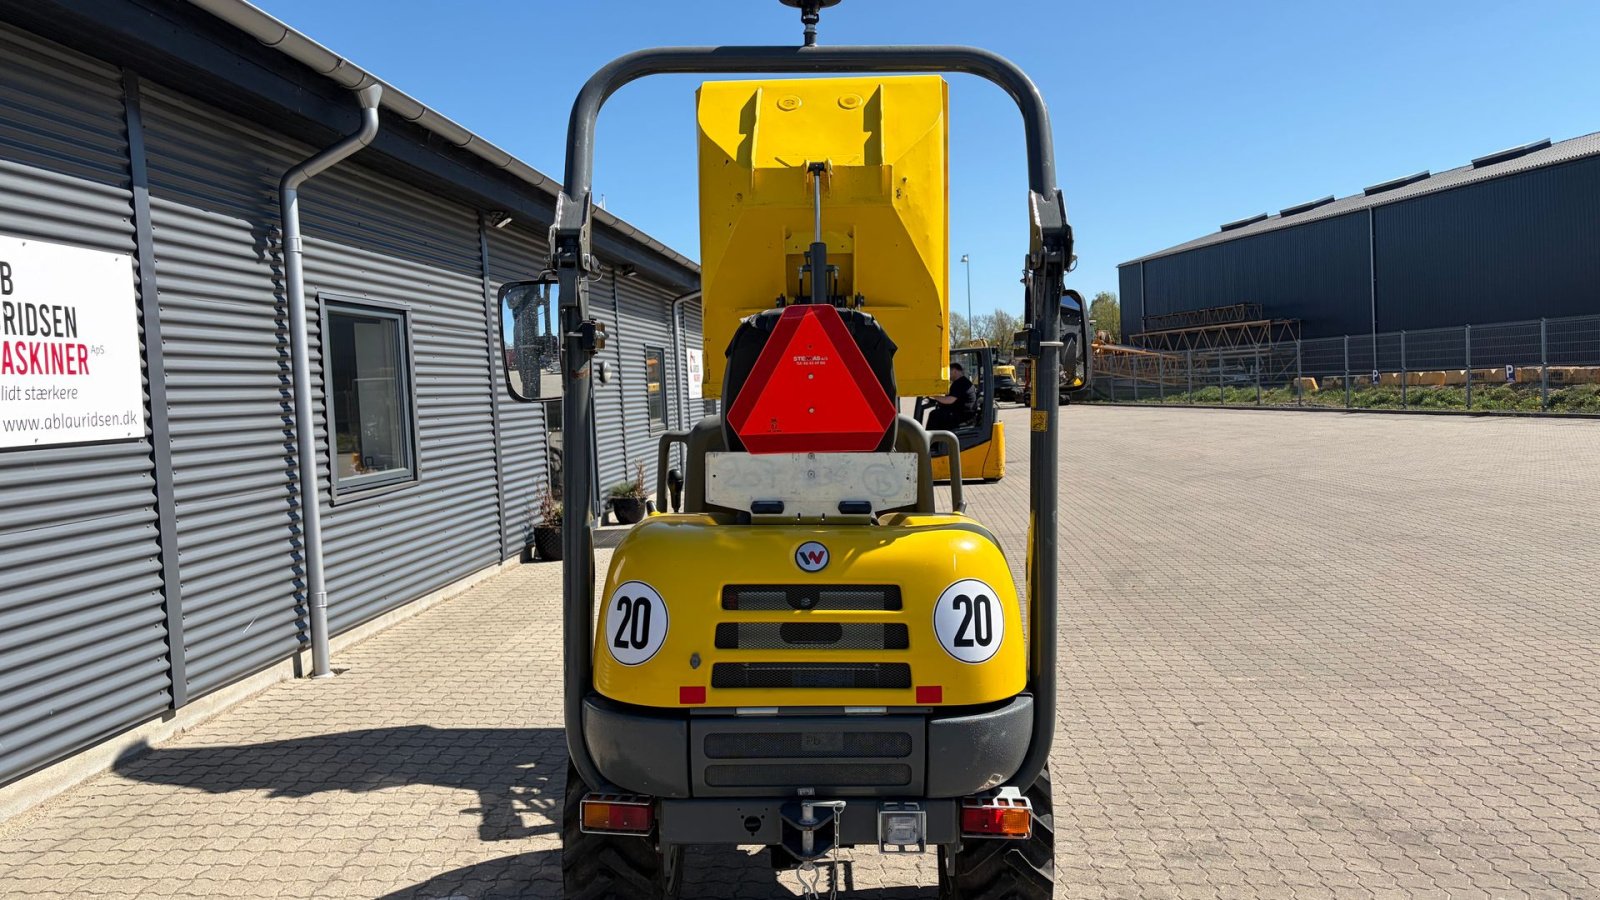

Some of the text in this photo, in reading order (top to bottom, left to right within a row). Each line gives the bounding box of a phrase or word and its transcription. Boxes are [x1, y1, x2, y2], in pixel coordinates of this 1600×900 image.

[0, 300, 77, 338] RIDSEN
[1, 385, 78, 400] lidt stærkere
[3, 410, 137, 432] www.ablauridsen.dk
[614, 596, 651, 649] 20
[953, 594, 992, 647] 20
